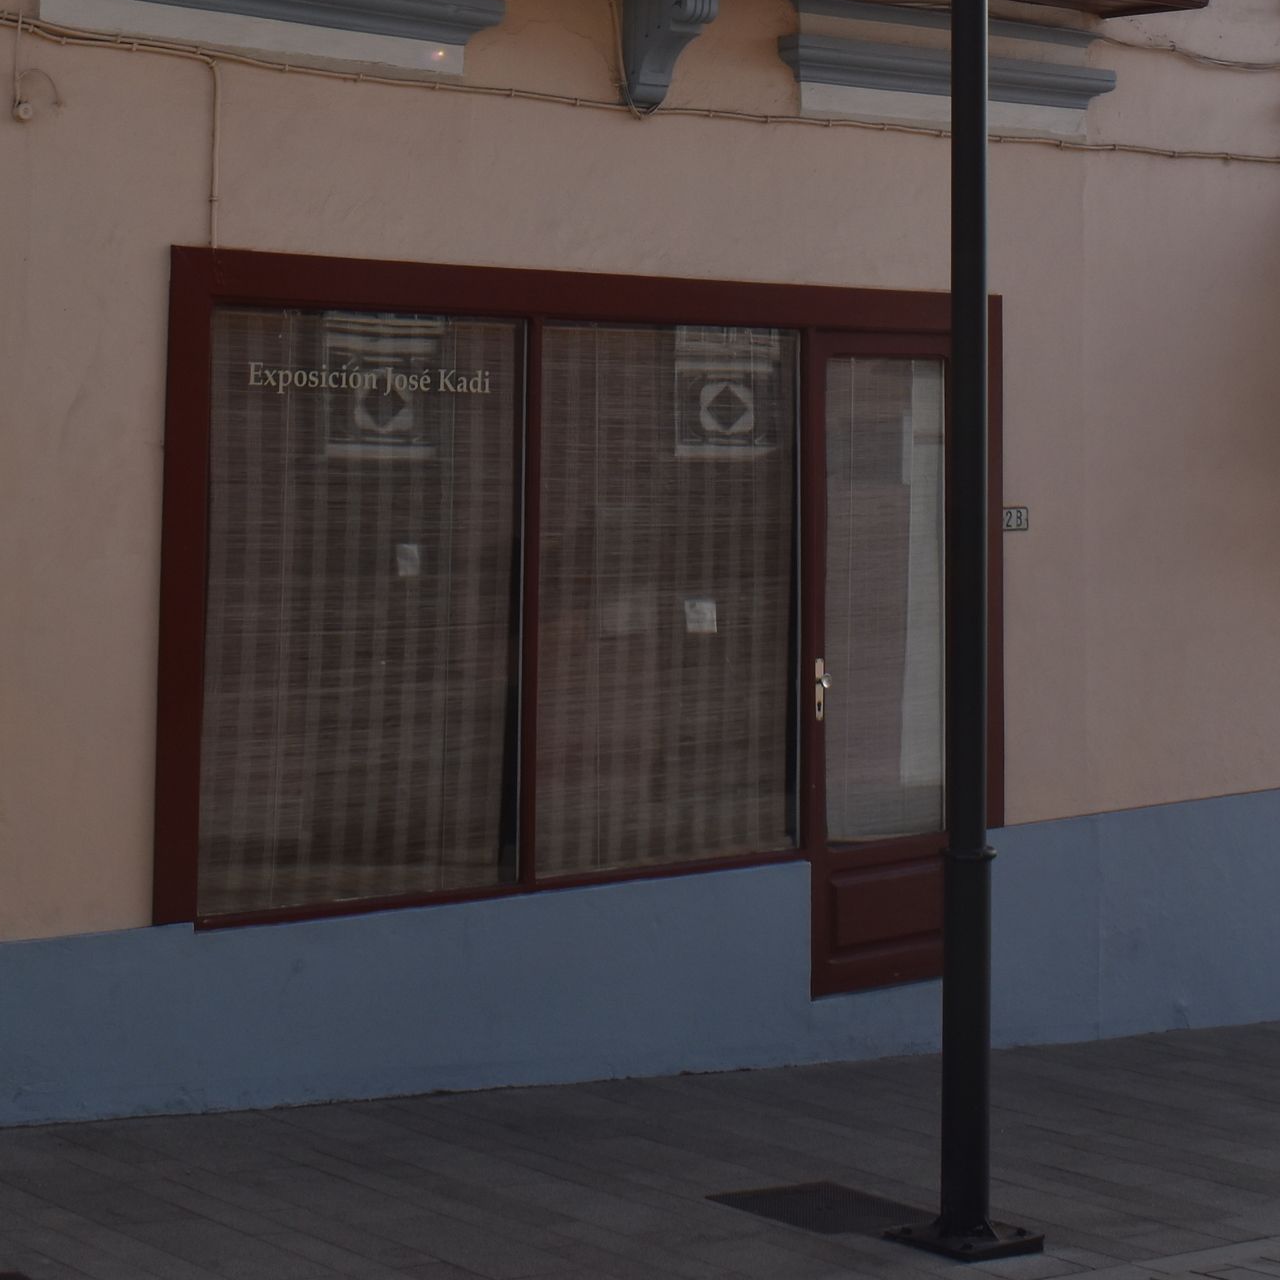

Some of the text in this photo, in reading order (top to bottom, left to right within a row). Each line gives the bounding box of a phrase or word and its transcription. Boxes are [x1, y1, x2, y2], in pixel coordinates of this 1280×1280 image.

[248, 361, 491, 397] Exposición José Kadi
